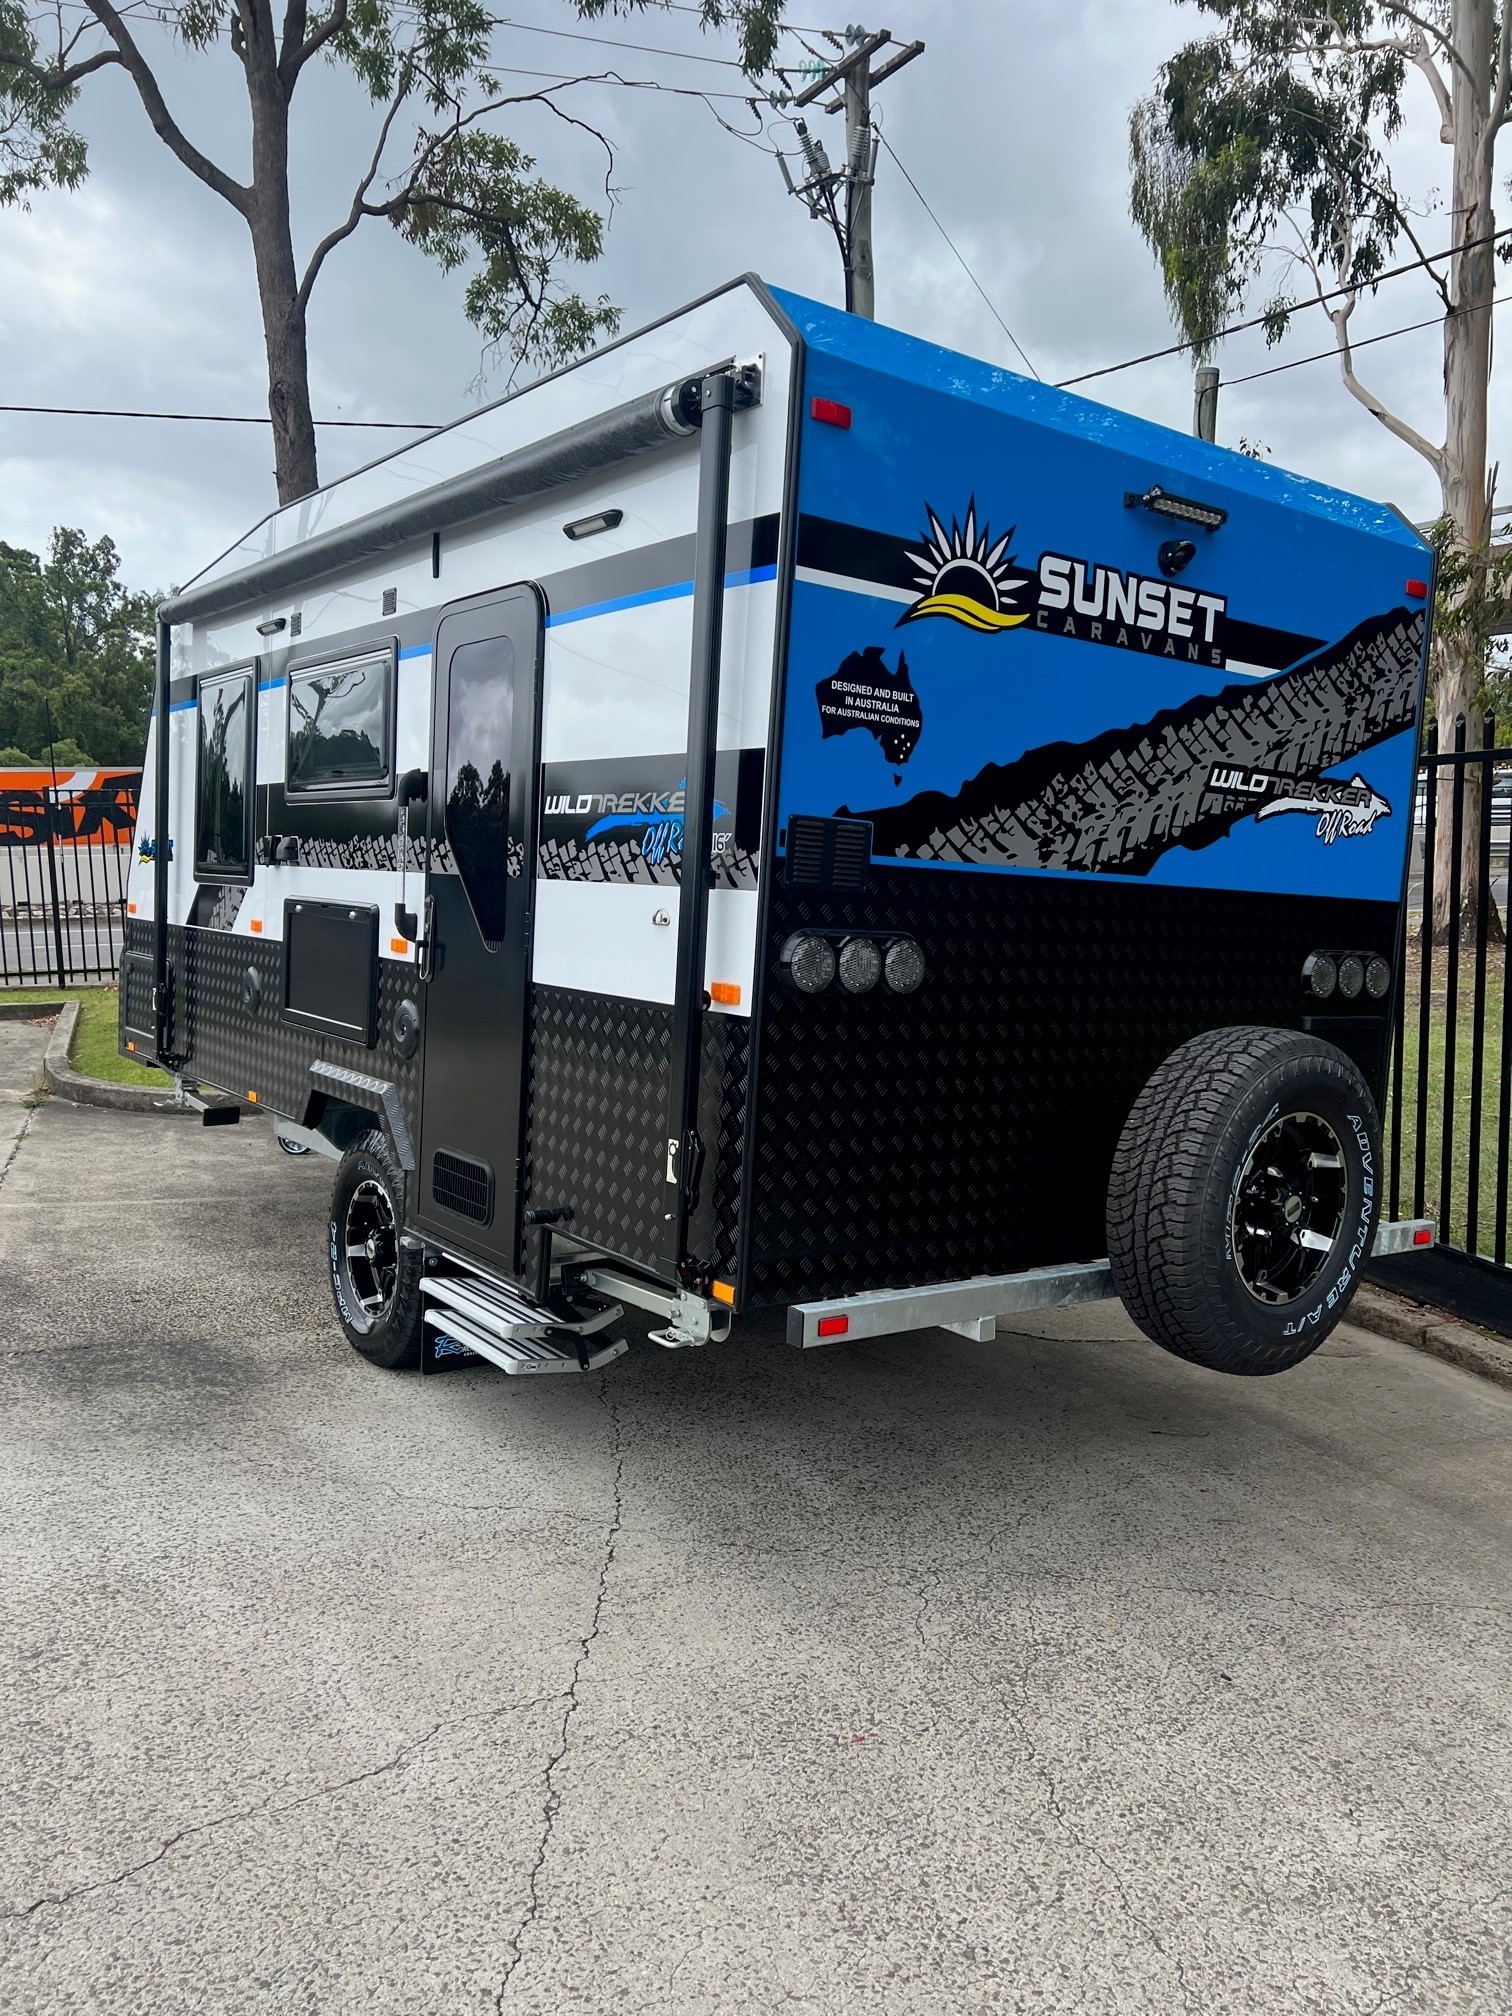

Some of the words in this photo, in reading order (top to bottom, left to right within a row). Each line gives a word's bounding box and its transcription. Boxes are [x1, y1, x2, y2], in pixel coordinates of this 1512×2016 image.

[1038, 555, 1225, 643] SUNSET
[1036, 610, 1222, 665] CARAVANS
[831, 680, 873, 696] DESIGNED
[873, 687, 891, 699] AND
[892, 690, 915, 703] BUILT
[845, 695, 854, 706] IN
[854, 697, 900, 713] AUSTRALIA
[821, 704, 837, 715] FOR
[836, 707, 880, 722] AUSTRALIAN
[880, 714, 920, 728] CONDITIONS
[544, 791, 686, 815] WILDTREKKE
[1326, 1114, 1374, 1310] ADVENTURE
[1282, 1303, 1323, 1336] A/T
